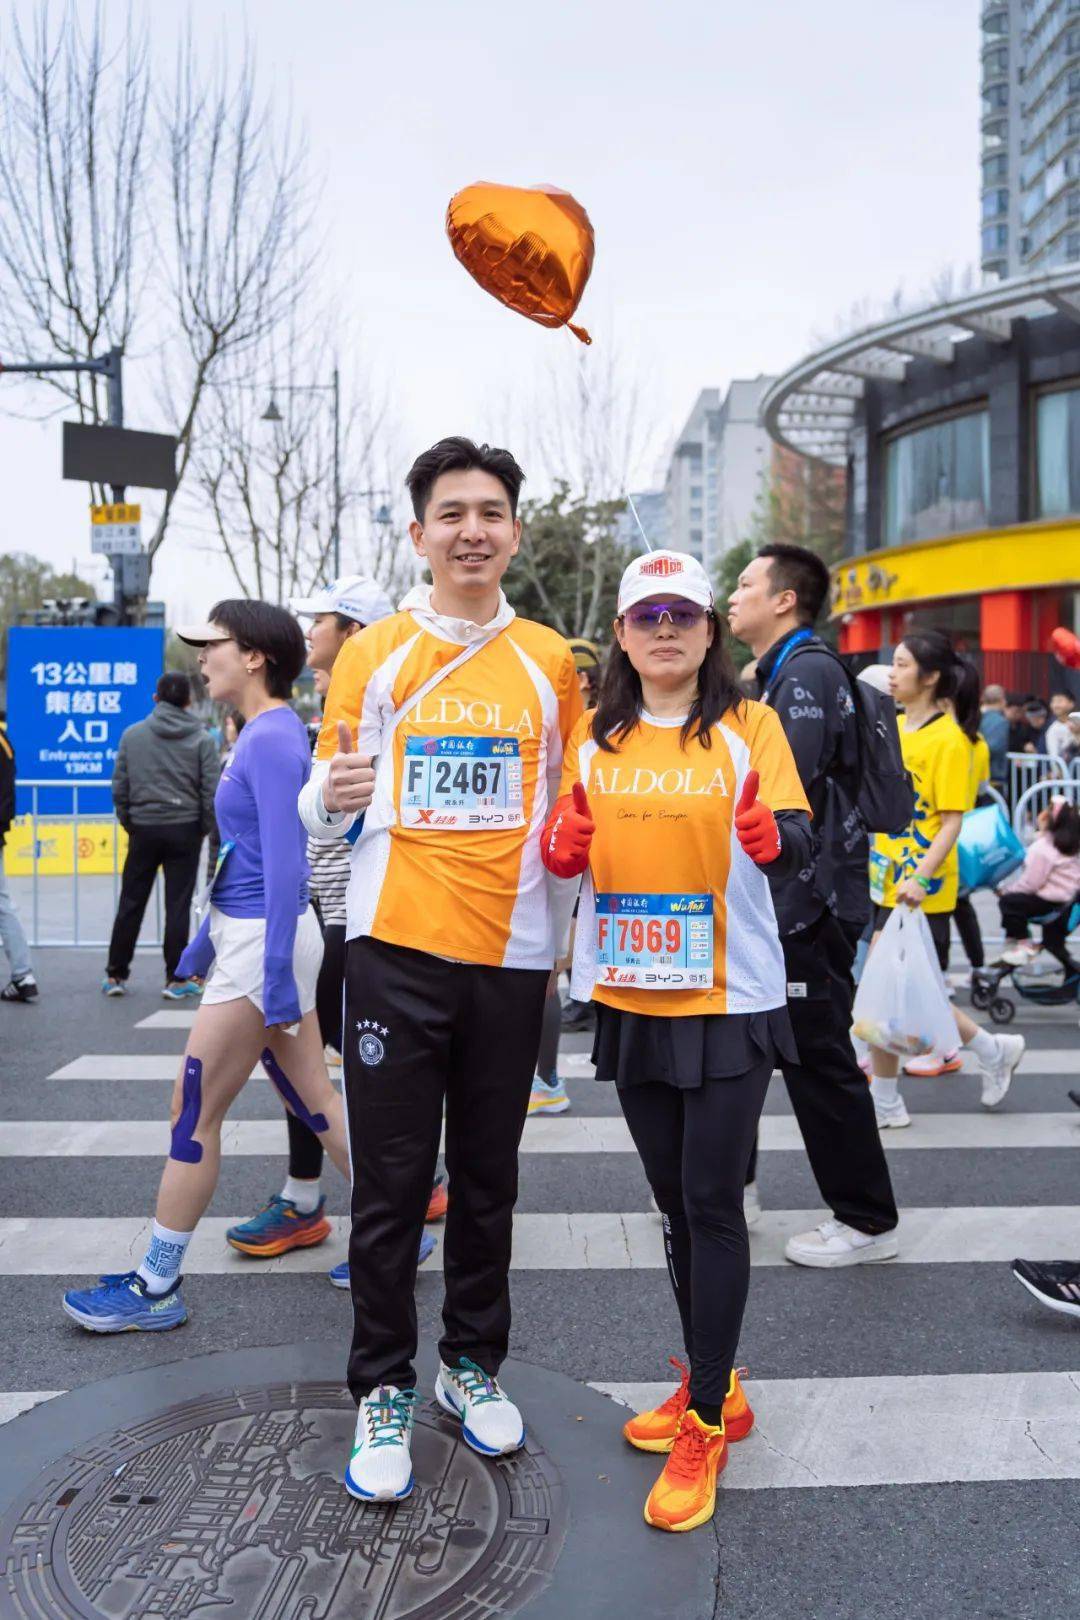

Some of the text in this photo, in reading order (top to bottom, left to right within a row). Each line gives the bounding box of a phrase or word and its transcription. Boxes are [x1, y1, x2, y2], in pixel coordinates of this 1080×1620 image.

[30, 661, 138, 686] 13公里跑
[45, 690, 122, 715] 集结区
[404, 698, 534, 737] LDOLA
[57, 719, 109, 744] 入口
[39, 748, 119, 762] Entrance fo
[65, 762, 103, 774] 13KM
[408, 760, 424, 793] F
[435, 761, 502, 795] 2467
[592, 767, 730, 797] ALDOLA
[468, 814, 504, 824] BYD
[617, 808, 638, 819] Care
[642, 810, 652, 821] for
[598, 918, 609, 951] F
[617, 918, 681, 954] 7969
[645, 973, 684, 983] BYD
[150, 1293, 178, 1313] HOKA
